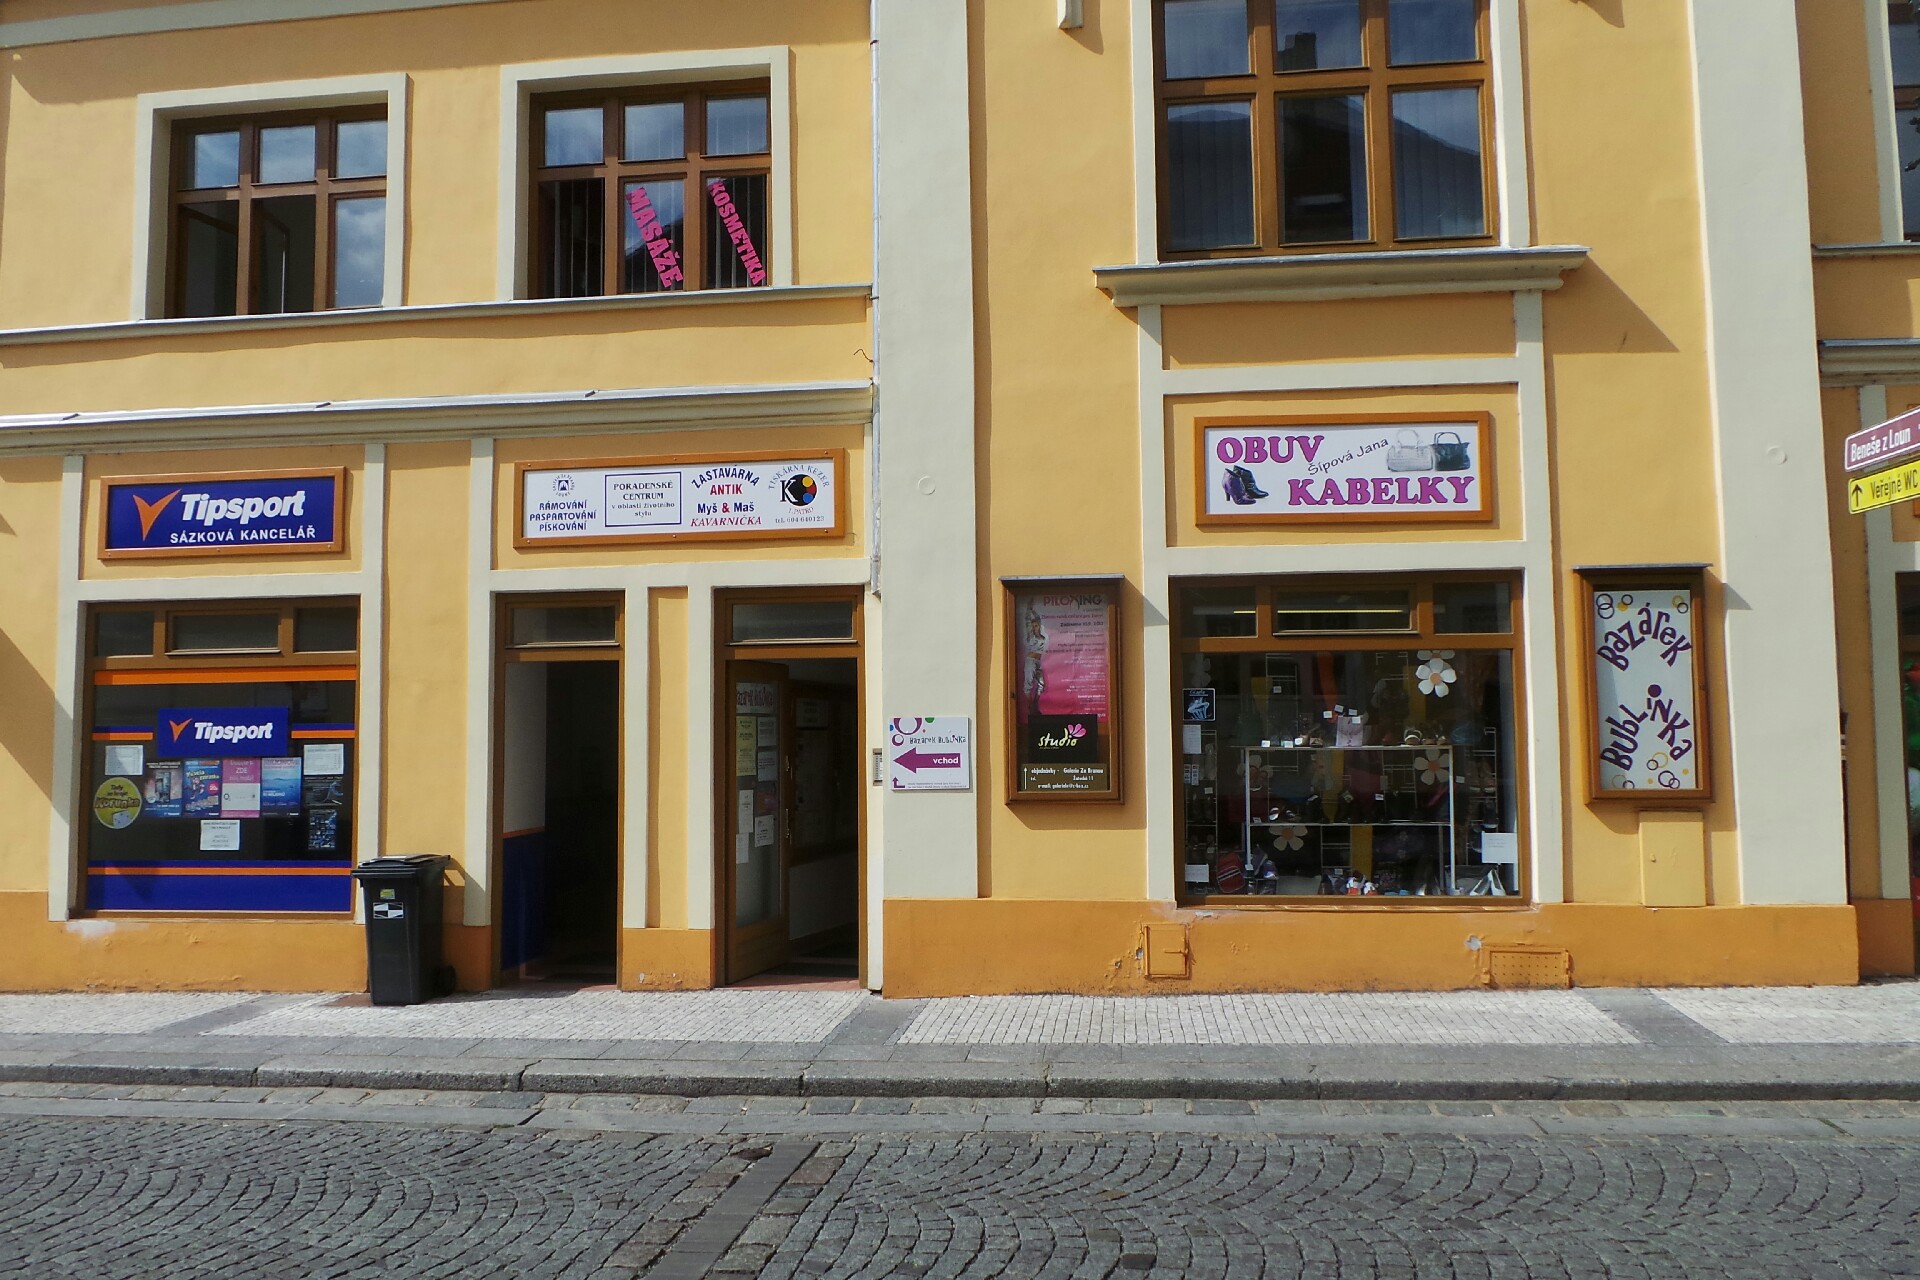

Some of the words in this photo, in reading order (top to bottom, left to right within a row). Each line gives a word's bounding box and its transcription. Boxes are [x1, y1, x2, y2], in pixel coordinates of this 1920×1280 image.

[625, 186, 684, 288] MASÁŽE
[707, 179, 766, 286] KOSMETIKA
[1216, 434, 1325, 464] OBUV
[1851, 435, 1881, 462] Beneše
[1882, 436, 1888, 451] z
[1889, 427, 1911, 449] Loun
[1308, 449, 1354, 476] Šípová
[1357, 436, 1389, 459] Jana
[613, 480, 674, 491] PORADENSKÉ
[691, 464, 760, 489] ZASTAVÁRNA
[768, 464, 805, 490] TISKÁRNA
[807, 465, 830, 488] KEZER
[1870, 474, 1901, 501] Veřejné
[1903, 468, 1918, 491] WC
[622, 492, 664, 501] CENTRUM
[709, 483, 743, 496] ANTIK
[1288, 476, 1475, 506] KABELKY
[180, 490, 306, 526] Tipsport
[529, 509, 597, 522] PASPARTOVÁNÍ
[539, 499, 588, 511] RÁMOVÁNÍ
[617, 502, 642, 510] oblasti
[643, 501, 675, 509] životního
[634, 510, 652, 518] stylu
[697, 502, 718, 516] Myš
[721, 502, 730, 514] &
[733, 501, 755, 513] Maš
[170, 528, 234, 544] SÁZKOVÁ
[240, 523, 316, 541] KANCELÁŘ
[539, 519, 587, 532] PÍSKOVÁNÍ
[194, 721, 273, 744] Tipsport
[1038, 727, 1079, 747] studio
[932, 756, 959, 765] vchod
